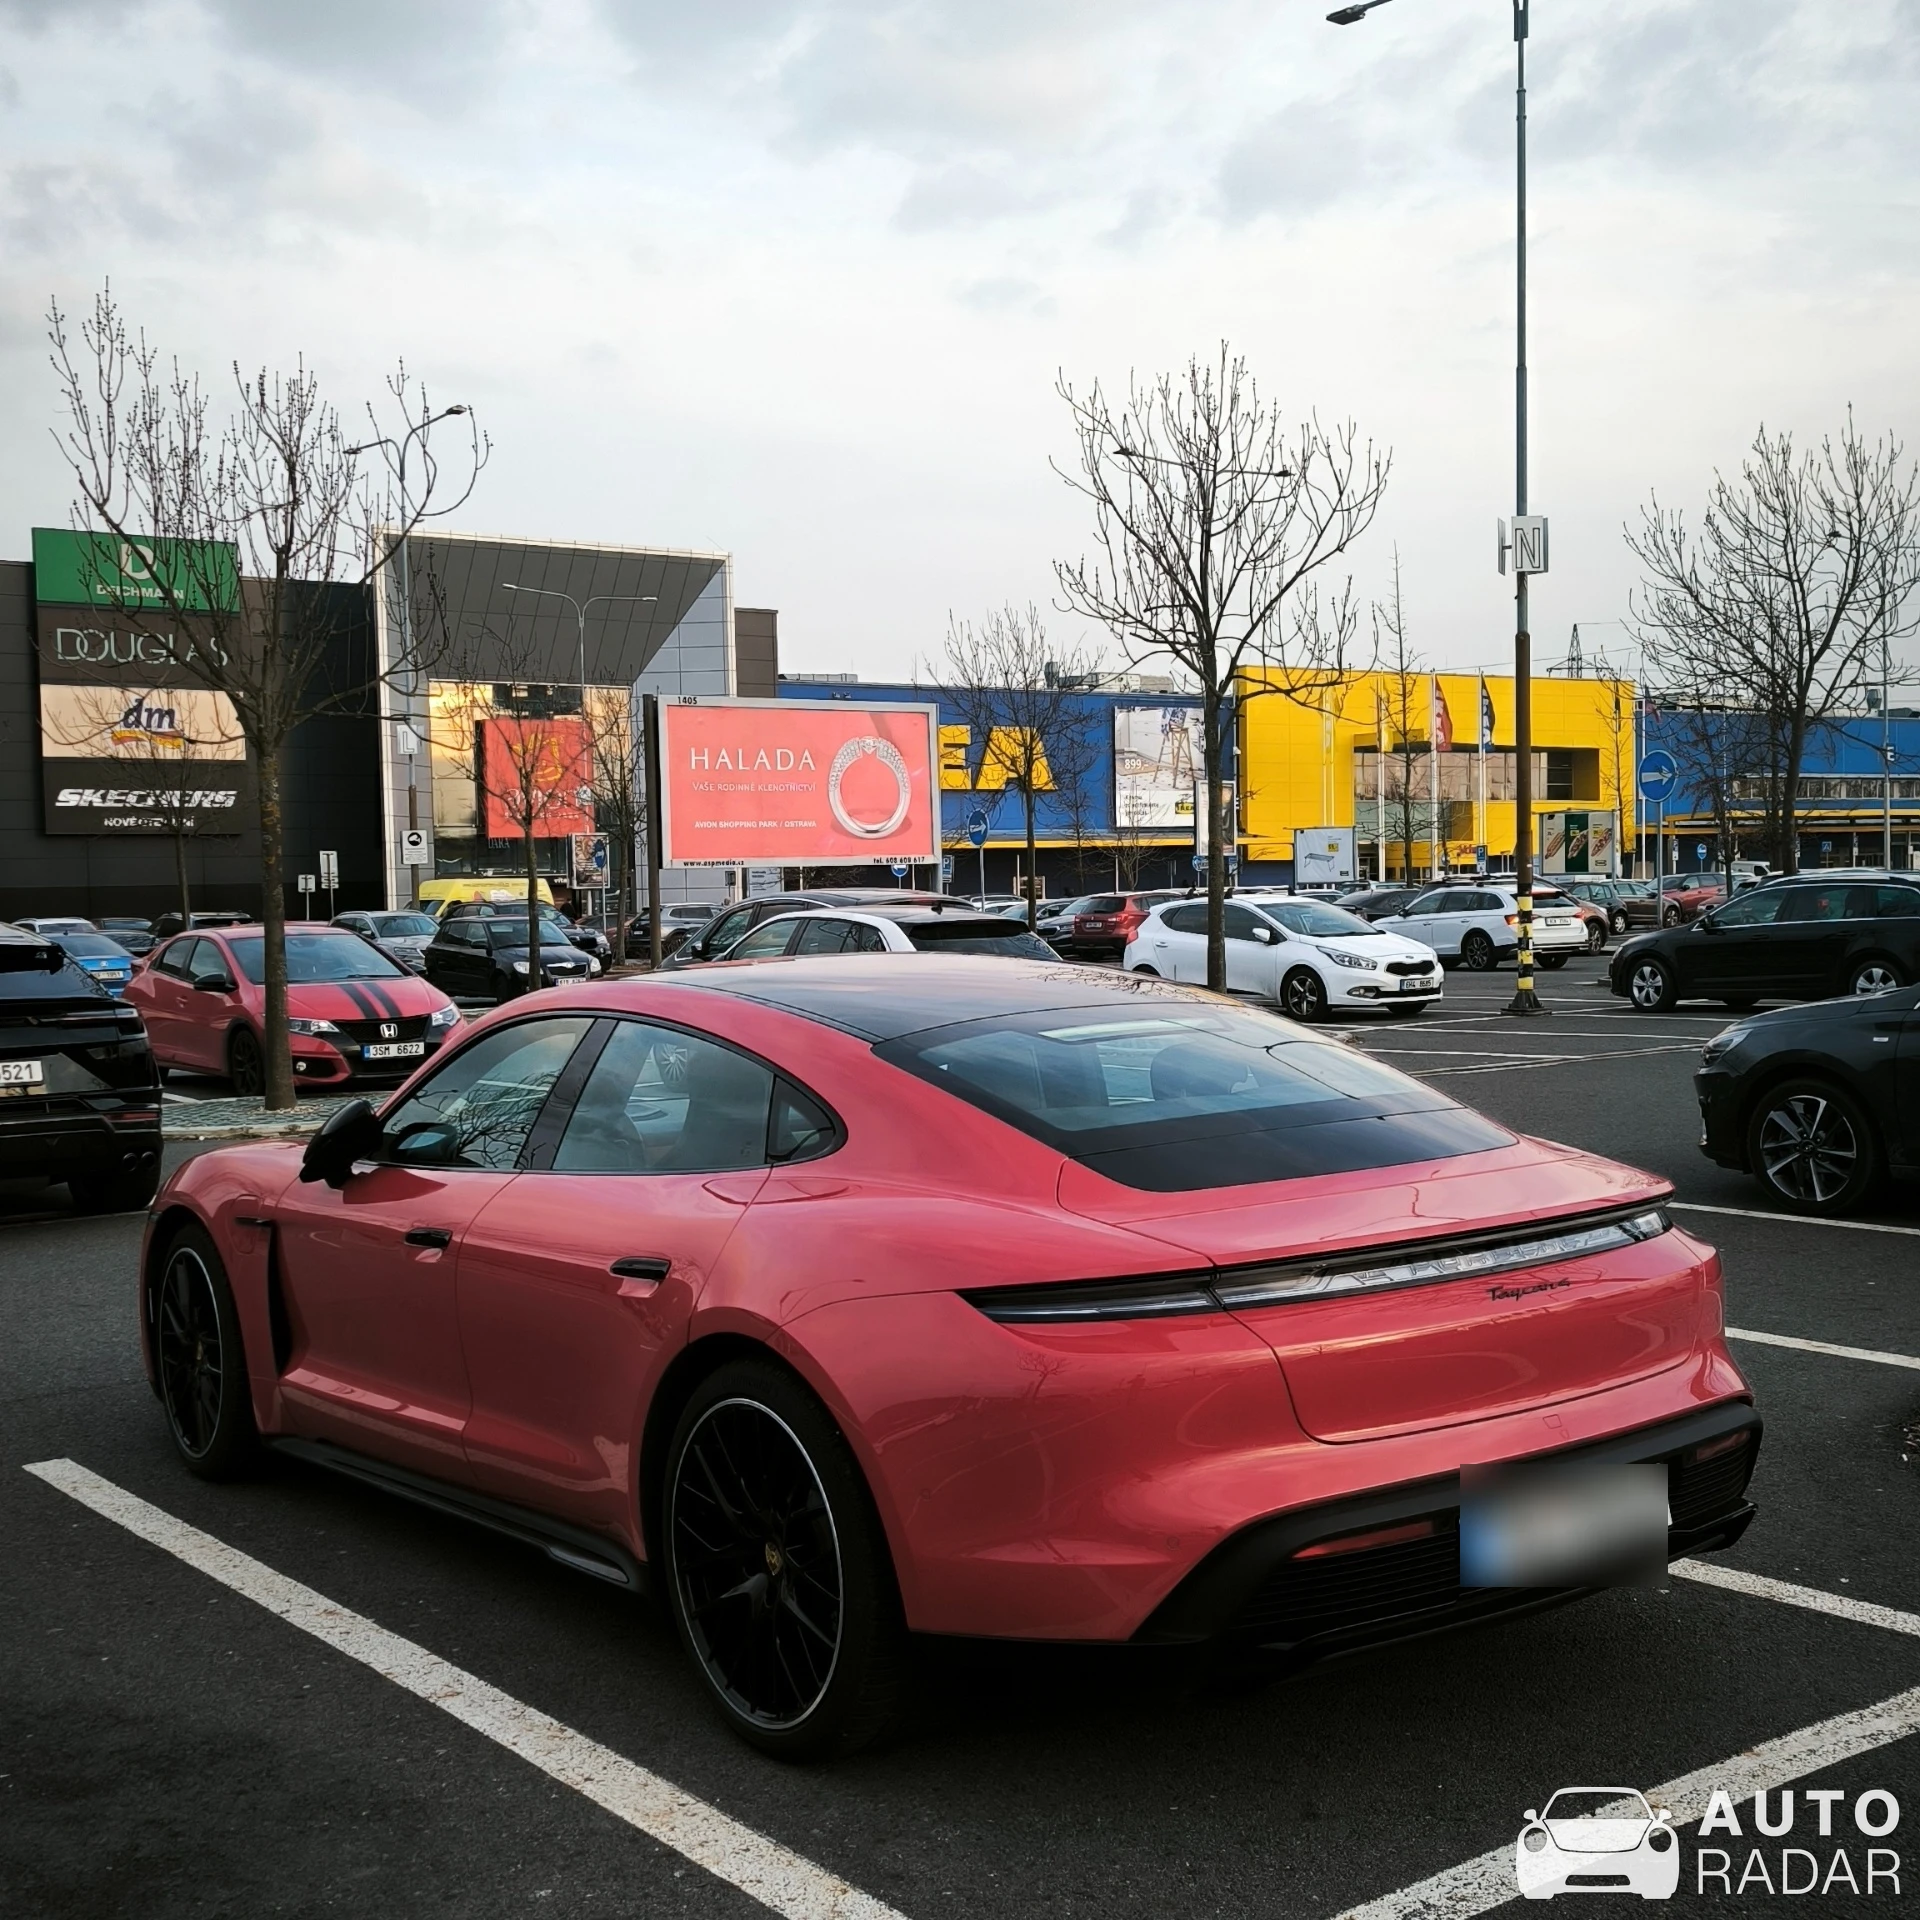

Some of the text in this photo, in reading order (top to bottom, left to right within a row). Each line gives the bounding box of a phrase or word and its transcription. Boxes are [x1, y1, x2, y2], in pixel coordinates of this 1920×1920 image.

[1515, 527, 1540, 569] N
[121, 543, 158, 580] D
[96, 584, 184, 600] DEICHMAN
[677, 696, 698, 705] 1405
[120, 698, 176, 729] dm
[403, 731, 415, 753] L
[690, 747, 816, 771] HALADA
[692, 782, 715, 791] VAŠE
[718, 782, 755, 791] RODINNÉ
[943, 857, 950, 868] P
[372, 1043, 420, 1056] 3SM 6622
[0, 1063, 33, 1081] 521
